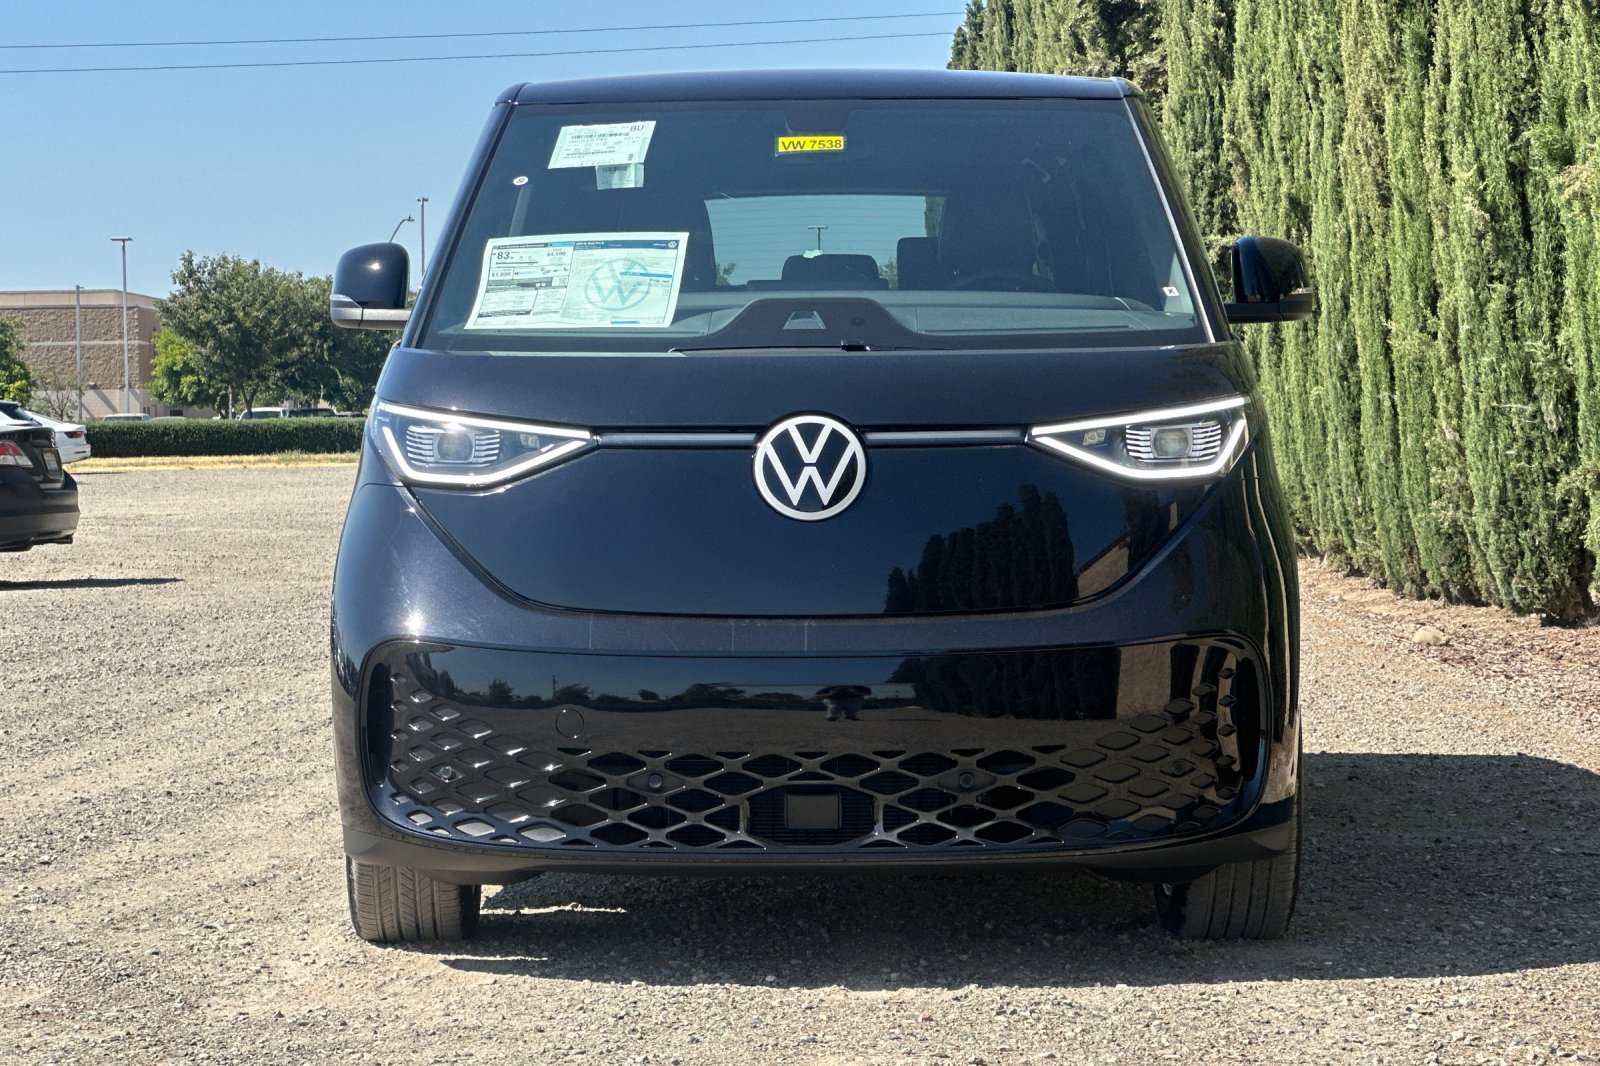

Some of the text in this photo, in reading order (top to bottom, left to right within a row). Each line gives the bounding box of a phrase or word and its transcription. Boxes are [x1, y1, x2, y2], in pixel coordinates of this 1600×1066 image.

[781, 139, 842, 150] VW 7538
[497, 251, 510, 260] 83
[760, 420, 860, 508] VW
